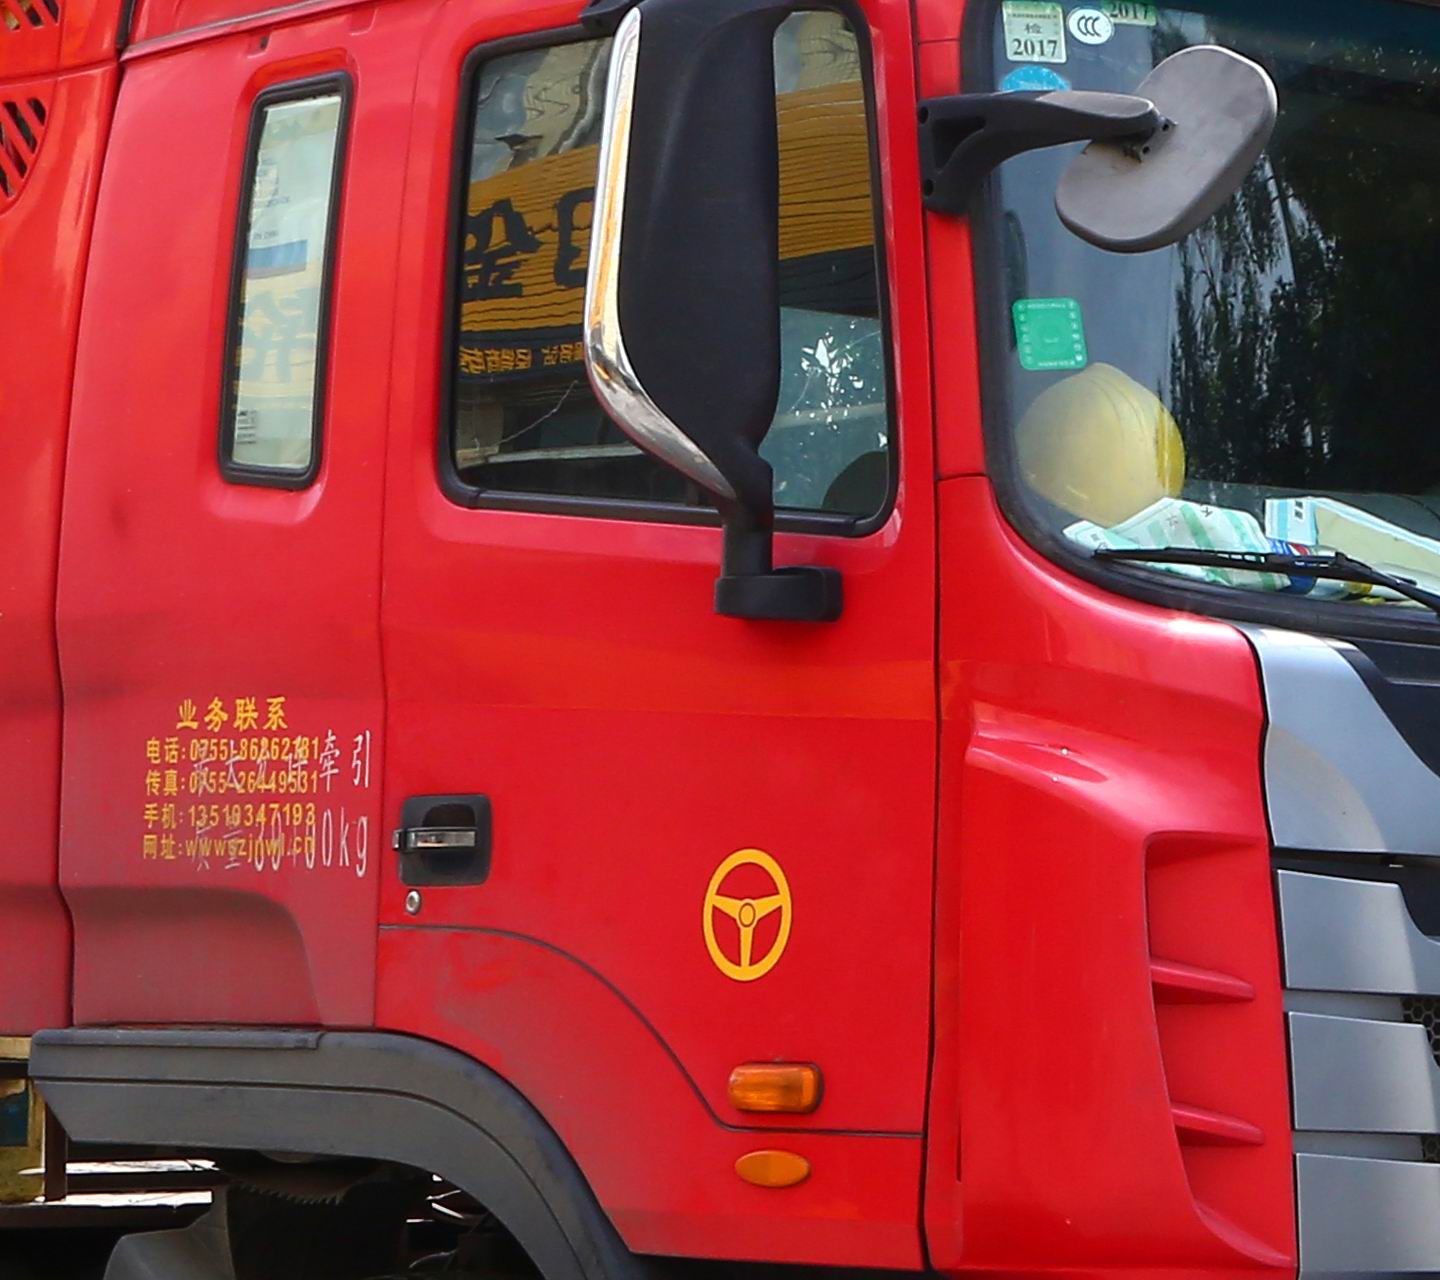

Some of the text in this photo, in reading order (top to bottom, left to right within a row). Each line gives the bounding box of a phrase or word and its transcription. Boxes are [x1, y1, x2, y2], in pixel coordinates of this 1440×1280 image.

[1012, 38, 1058, 57] 2017
[176, 695, 289, 732] 业务联系
